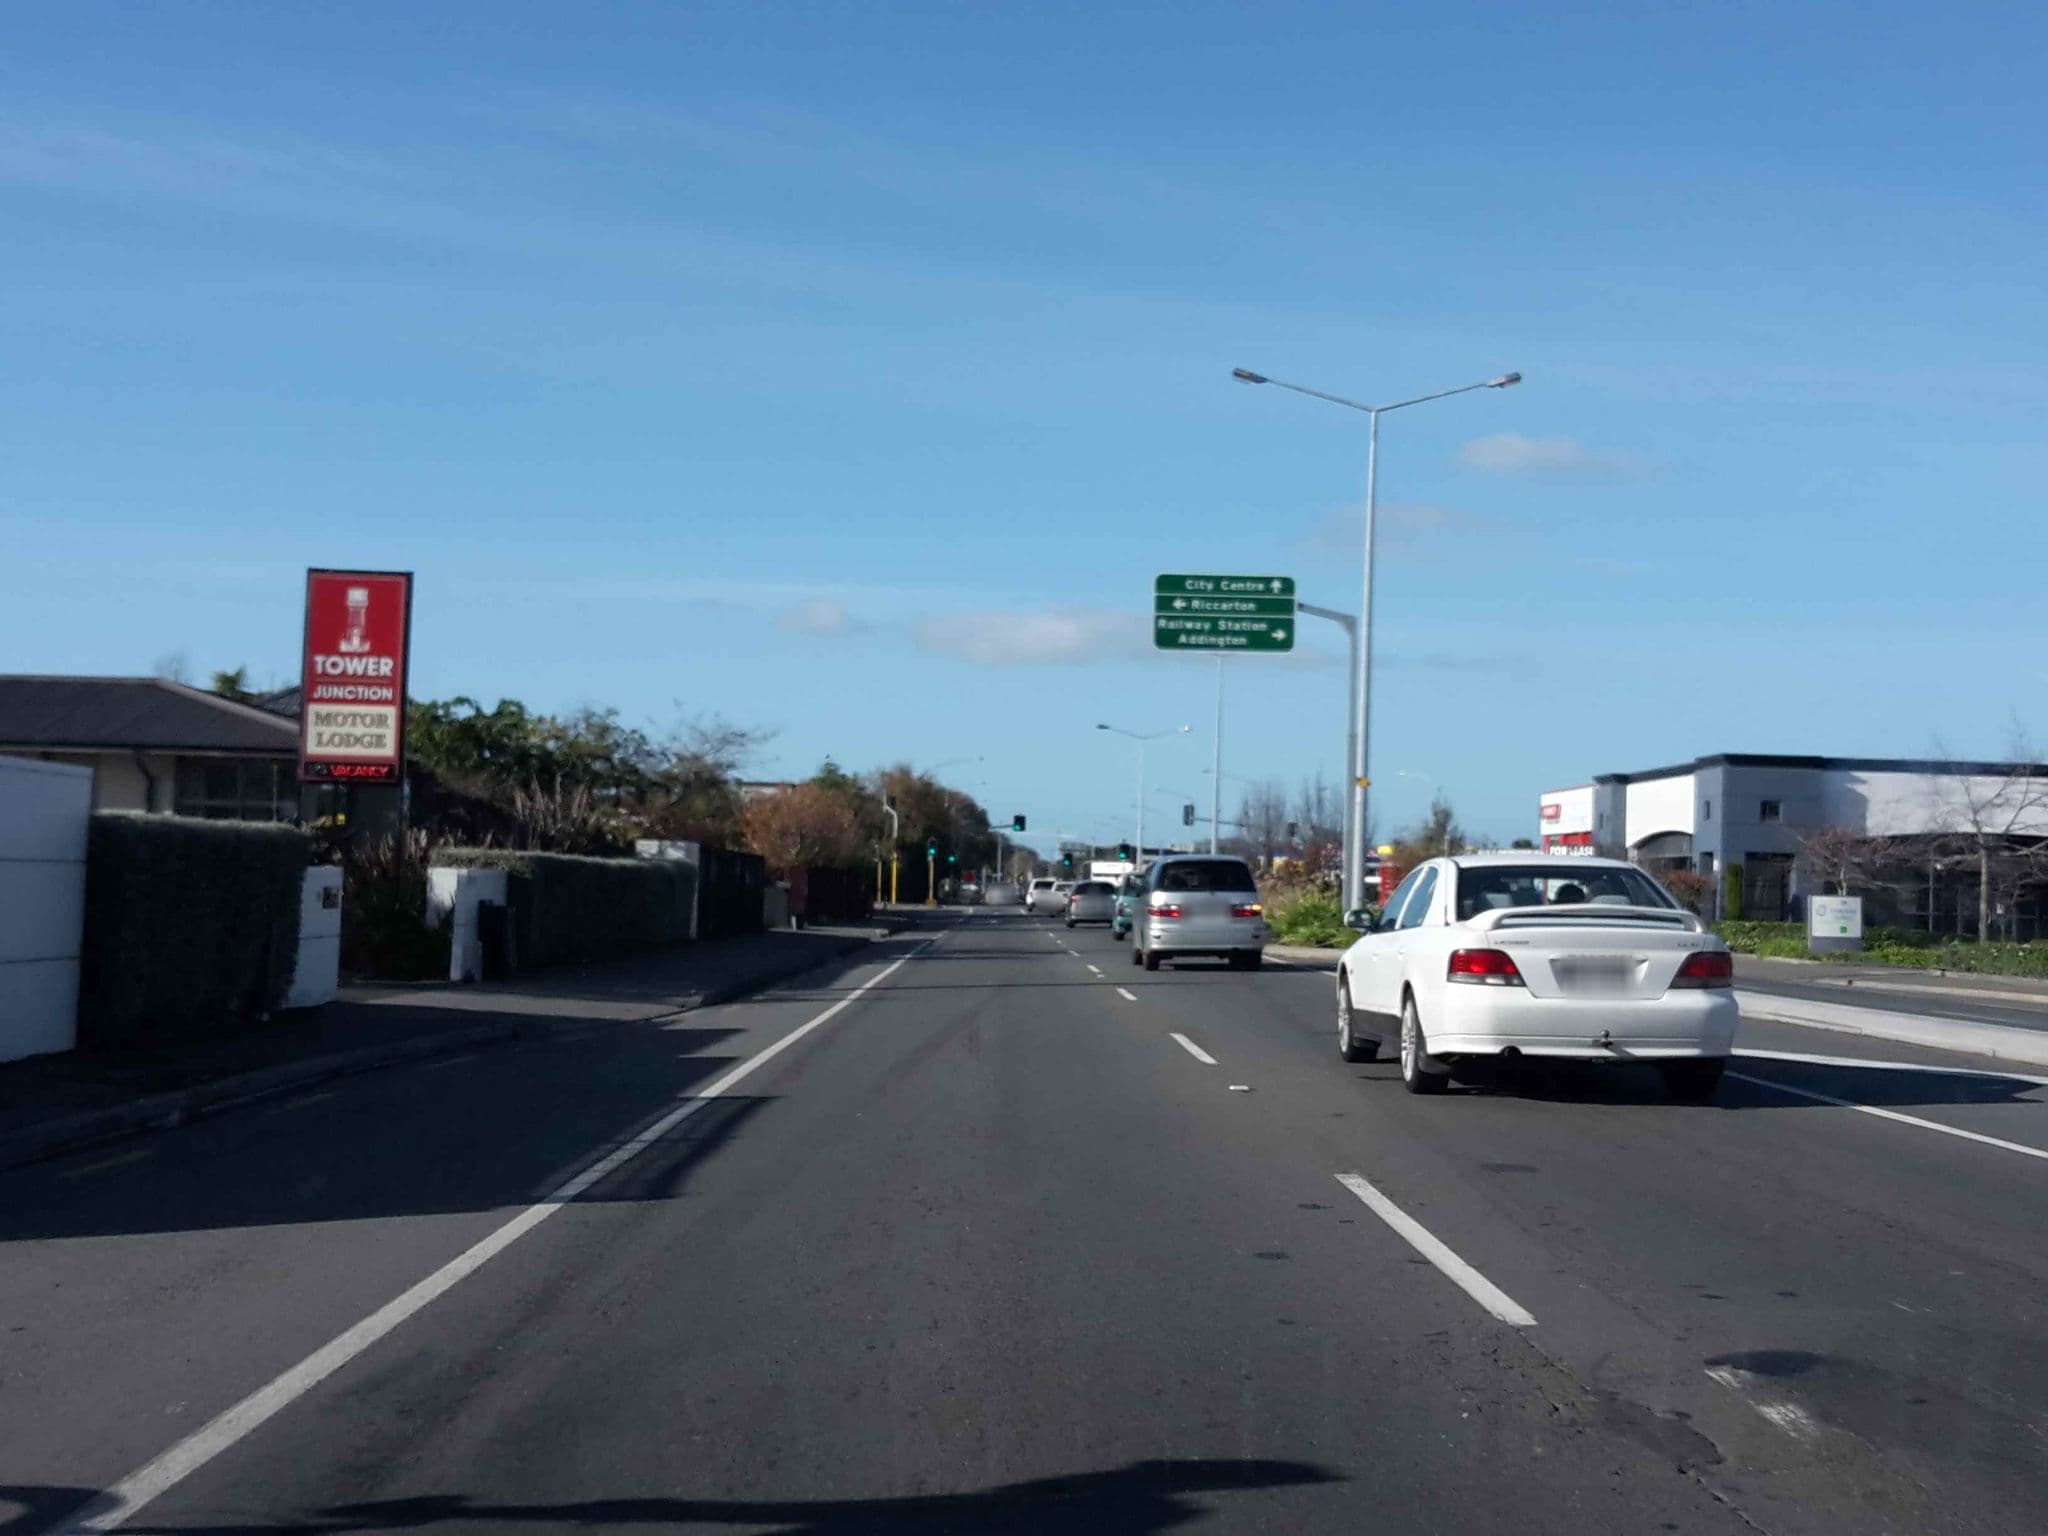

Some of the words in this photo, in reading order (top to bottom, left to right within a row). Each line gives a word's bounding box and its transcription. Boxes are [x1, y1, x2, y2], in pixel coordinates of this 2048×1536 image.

[1184, 579, 1214, 592] City
[1220, 580, 1265, 592] Centre
[1191, 599, 1256, 611] Riccarton
[1157, 618, 1211, 631] Railway
[1218, 619, 1268, 631] Station
[1177, 633, 1247, 647] Addington
[314, 656, 394, 676] TOWER
[314, 686, 392, 700] JUNCTION
[315, 712, 389, 728] MOTOR
[315, 732, 386, 748] LODGE
[331, 764, 389, 776] VACANCY
[1550, 846, 1567, 856] FOR
